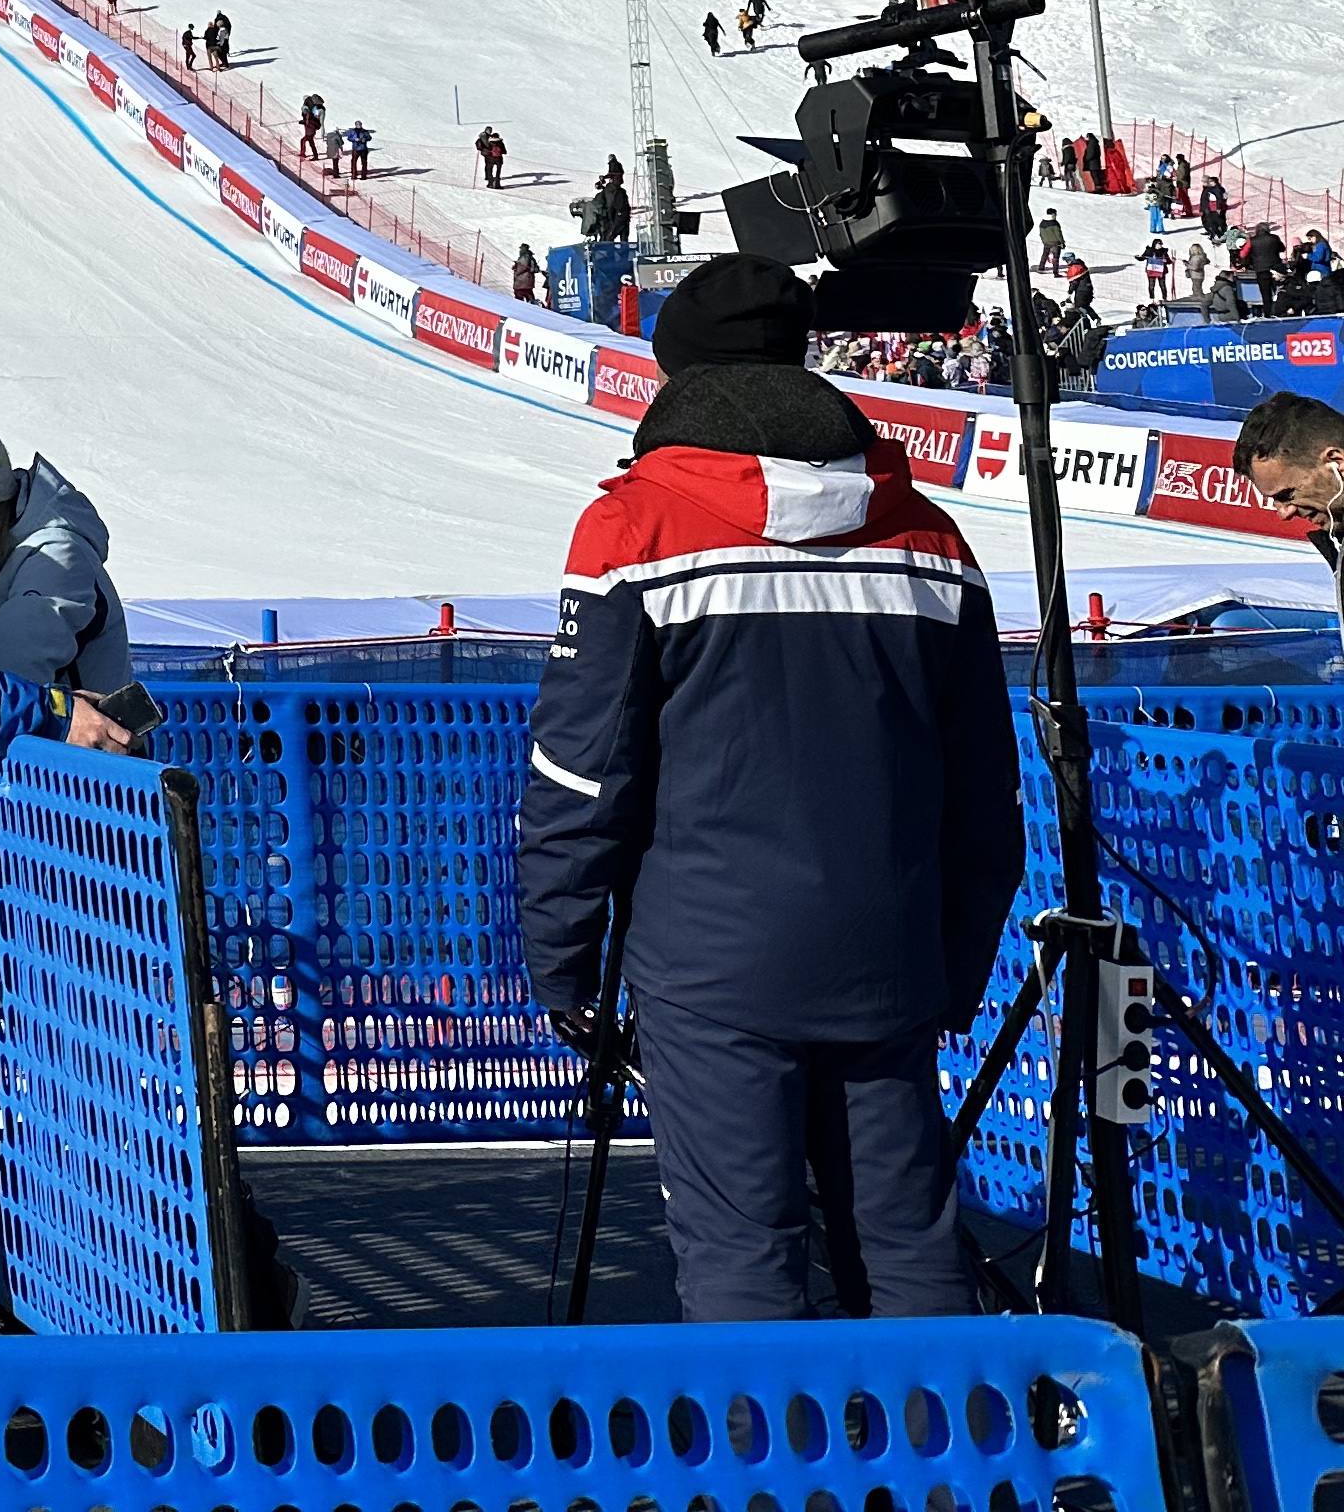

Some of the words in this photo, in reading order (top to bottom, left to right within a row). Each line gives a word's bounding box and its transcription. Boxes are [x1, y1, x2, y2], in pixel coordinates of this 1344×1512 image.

[272, 218, 299, 256] WÜRTH
[314, 249, 353, 289] GENERALI
[370, 278, 411, 320] WÜRTH
[431, 310, 494, 354] GENERALI
[525, 342, 585, 384] WÜRTH
[1105, 347, 1208, 370] COURCHEVEL
[1212, 341, 1284, 363] MÉRIBEL
[1290, 339, 1332, 358] 2023
[615, 370, 660, 405] GENE
[1020, 443, 1139, 488] ÜRTH
